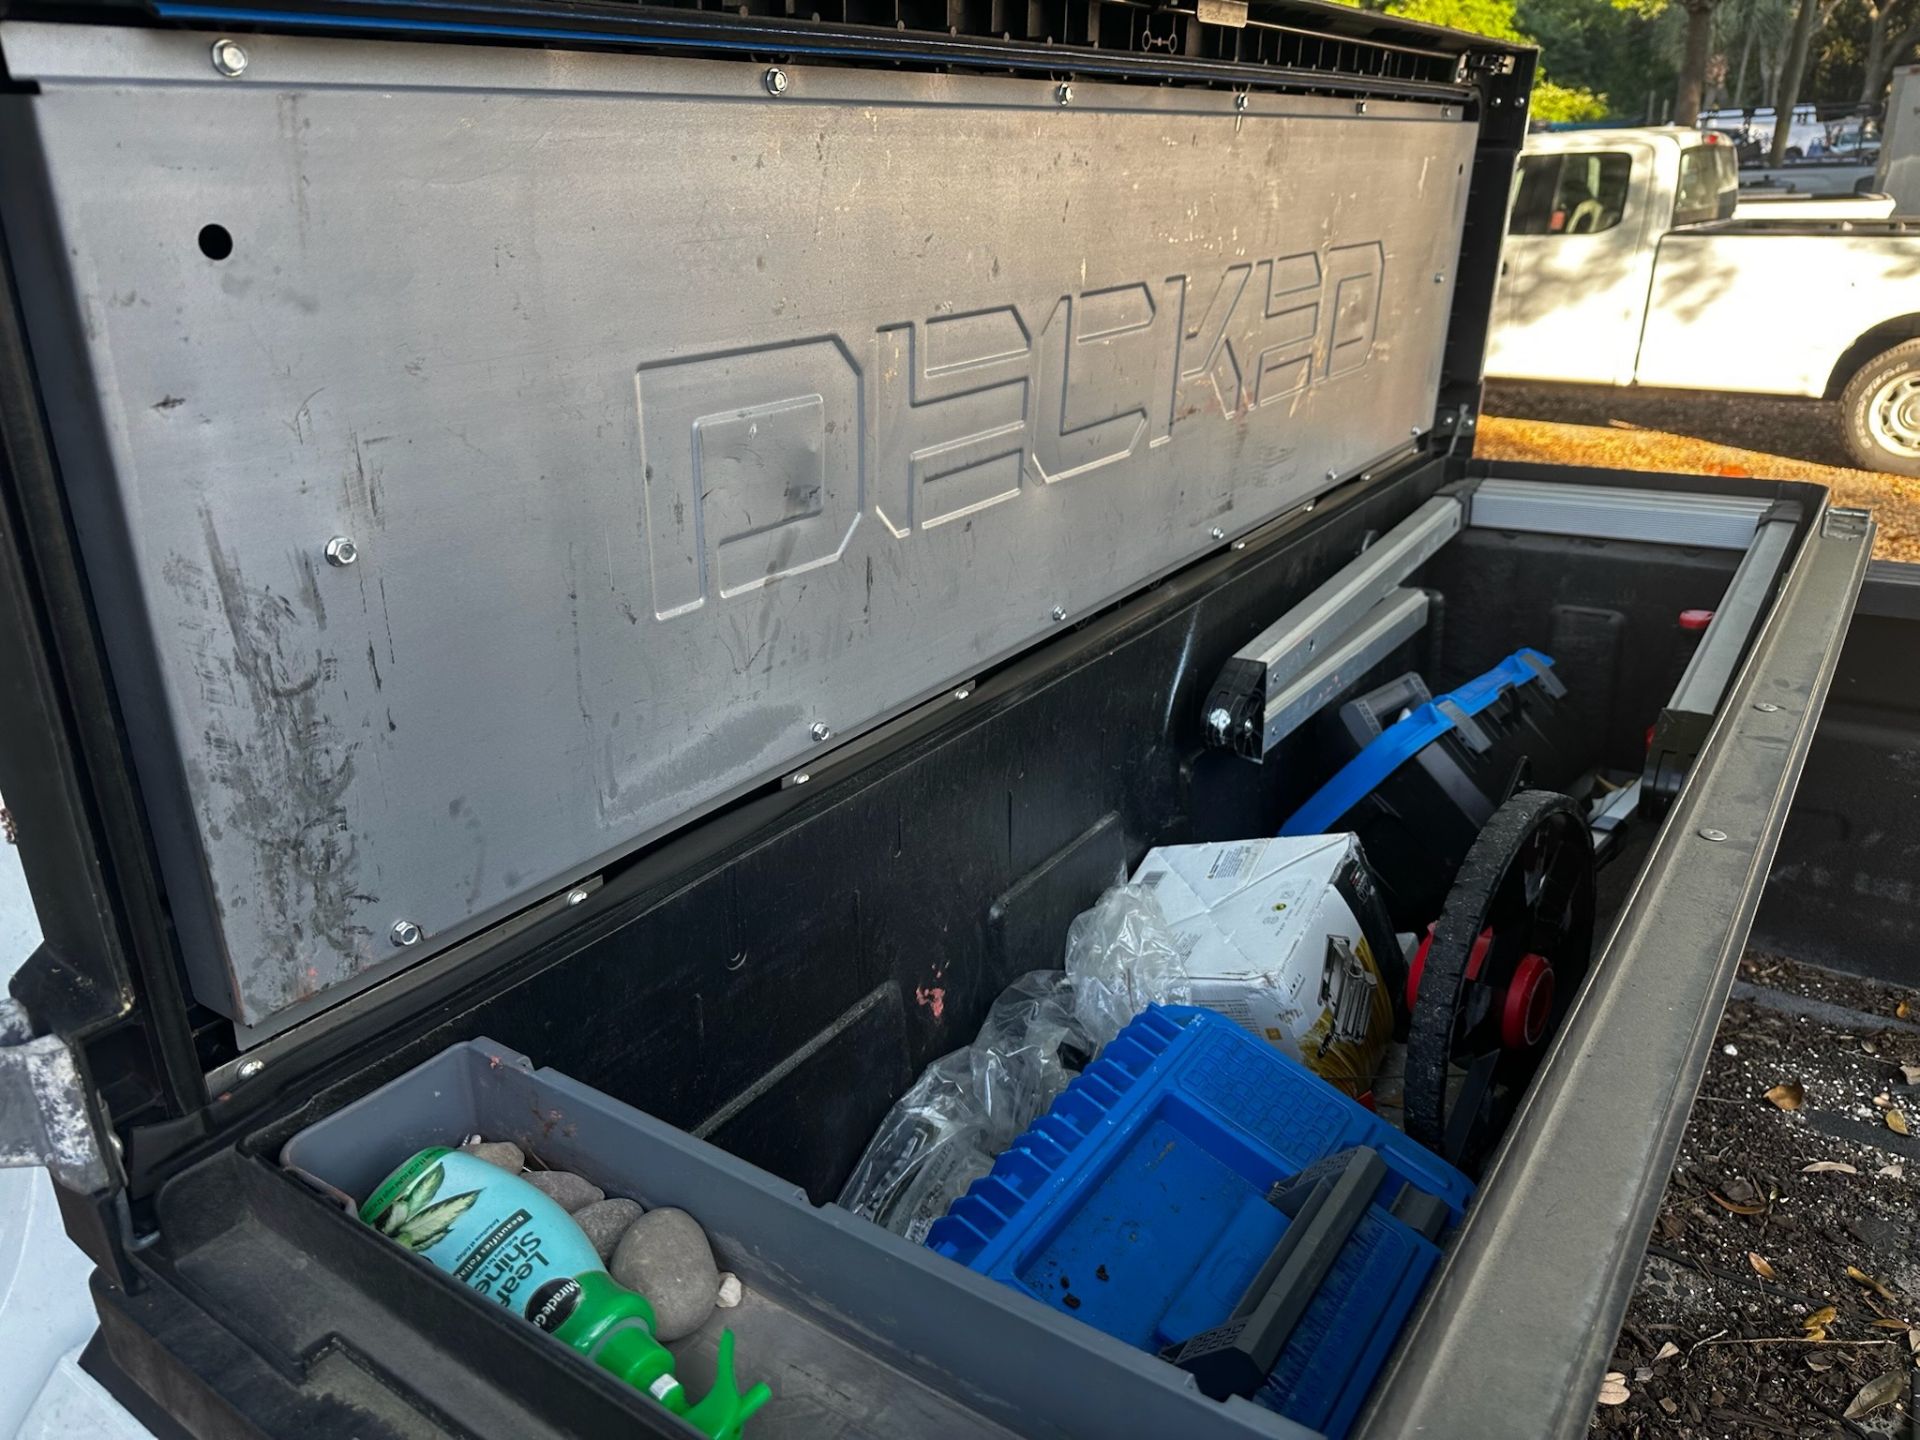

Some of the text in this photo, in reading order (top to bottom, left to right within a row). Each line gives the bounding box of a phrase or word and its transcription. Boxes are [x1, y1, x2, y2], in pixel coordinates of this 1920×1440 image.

[634, 240, 1385, 622] DECKED
[456, 1215, 524, 1279] Beautifies Foliag
[496, 1251, 549, 1307] Leaf
[532, 1279, 581, 1327] Miracle-Gr
